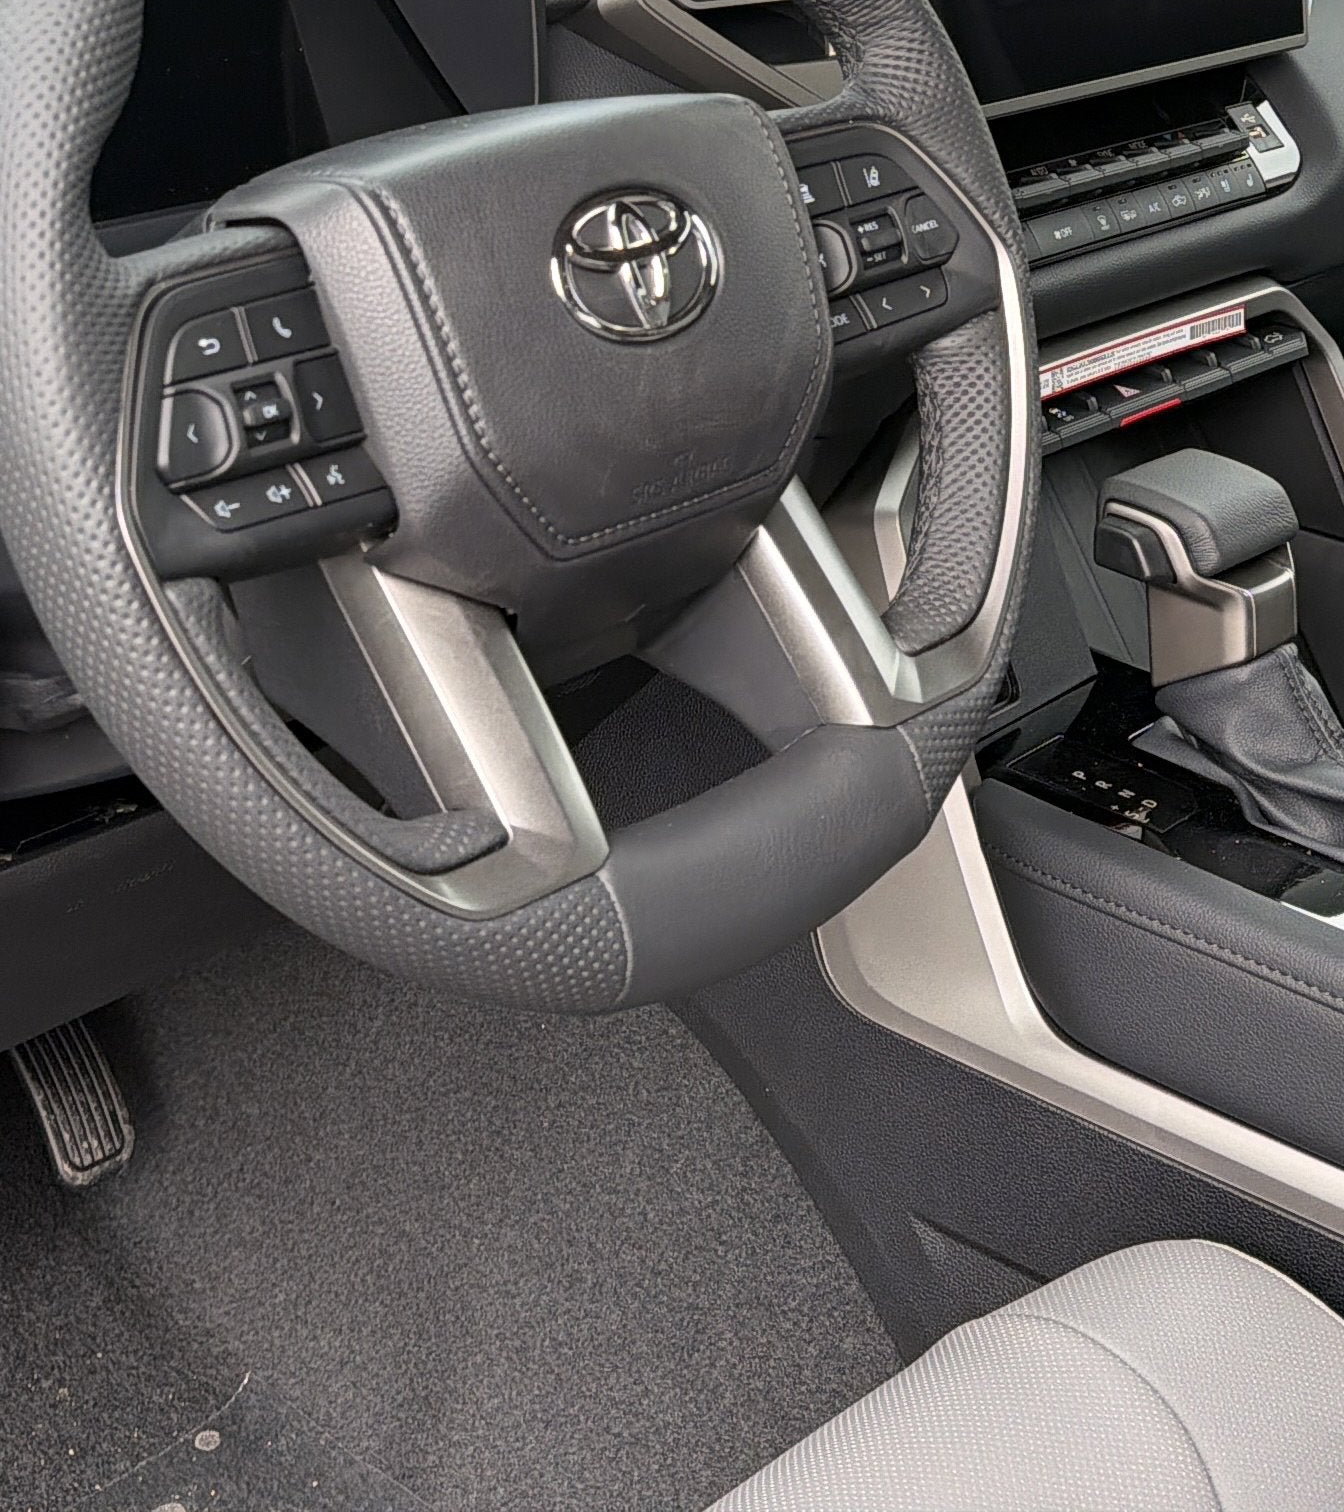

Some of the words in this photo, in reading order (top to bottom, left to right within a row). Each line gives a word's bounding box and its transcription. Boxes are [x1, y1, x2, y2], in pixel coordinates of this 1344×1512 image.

[911, 219, 940, 234] CANCEL
[1072, 770, 1087, 780] P
[1094, 780, 1113, 790] R
[1117, 788, 1136, 799] N
[1141, 799, 1158, 808] D
